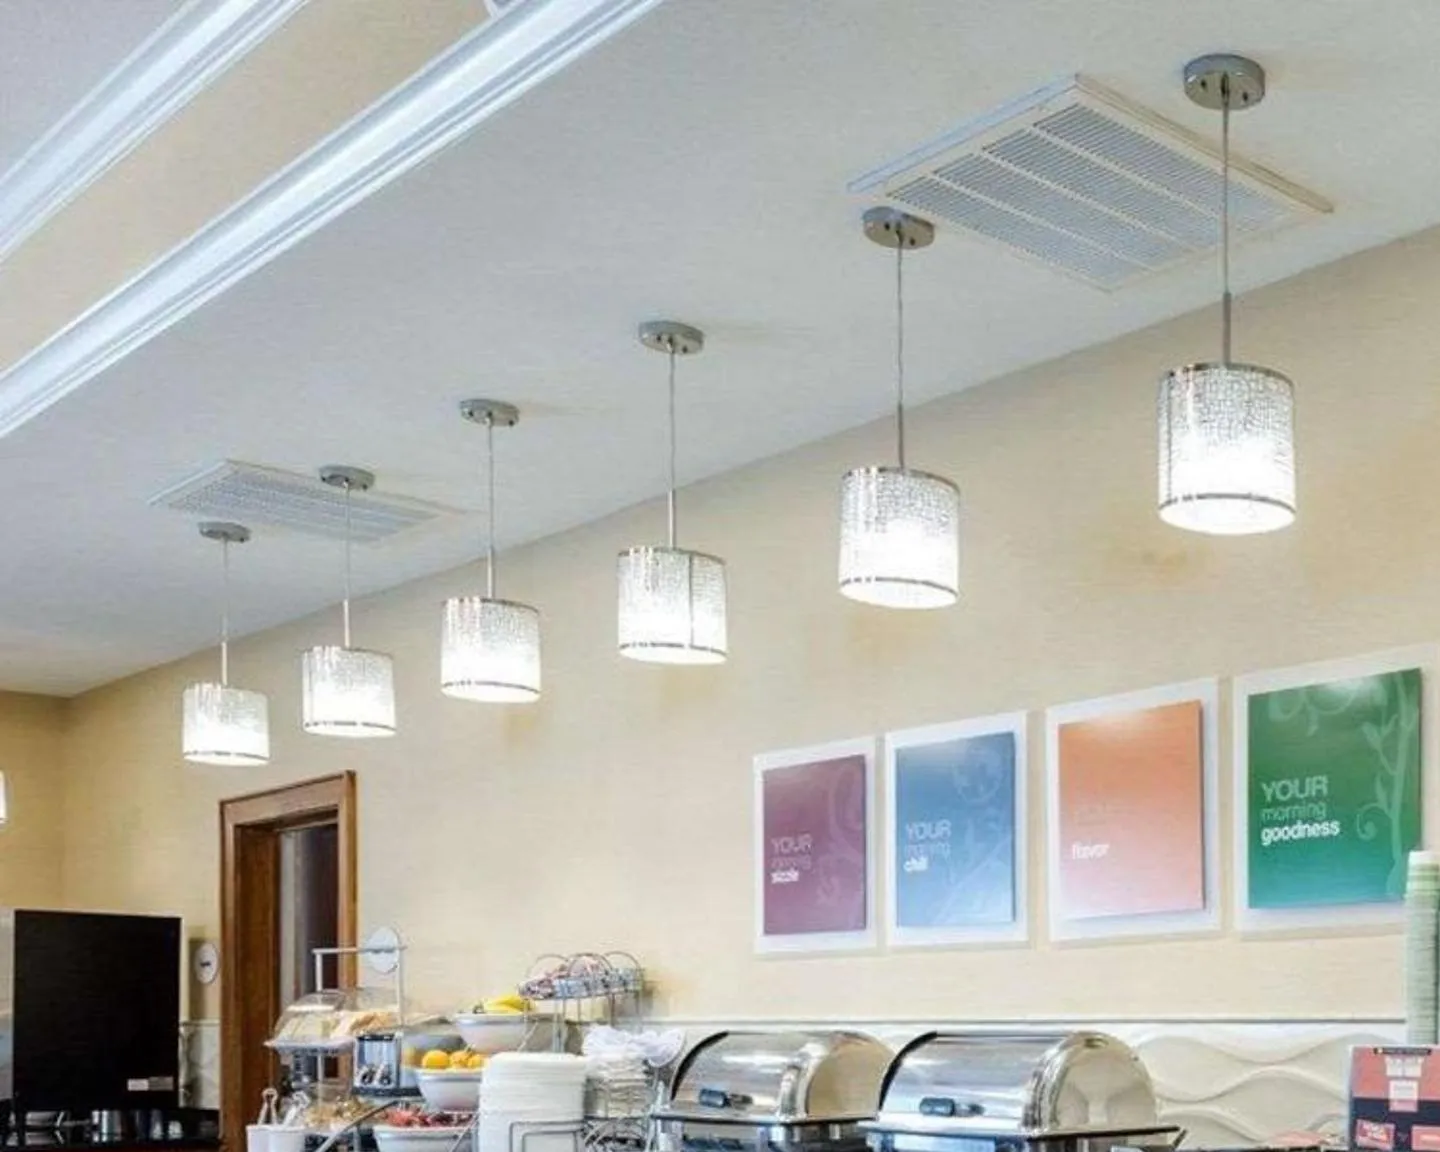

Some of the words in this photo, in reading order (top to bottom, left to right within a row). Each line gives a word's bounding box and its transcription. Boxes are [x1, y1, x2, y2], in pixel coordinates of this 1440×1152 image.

[1261, 775, 1328, 802] YOUR
[1261, 802, 1327, 822] morning
[905, 819, 952, 840] YOUR
[1261, 820, 1341, 846] goodness
